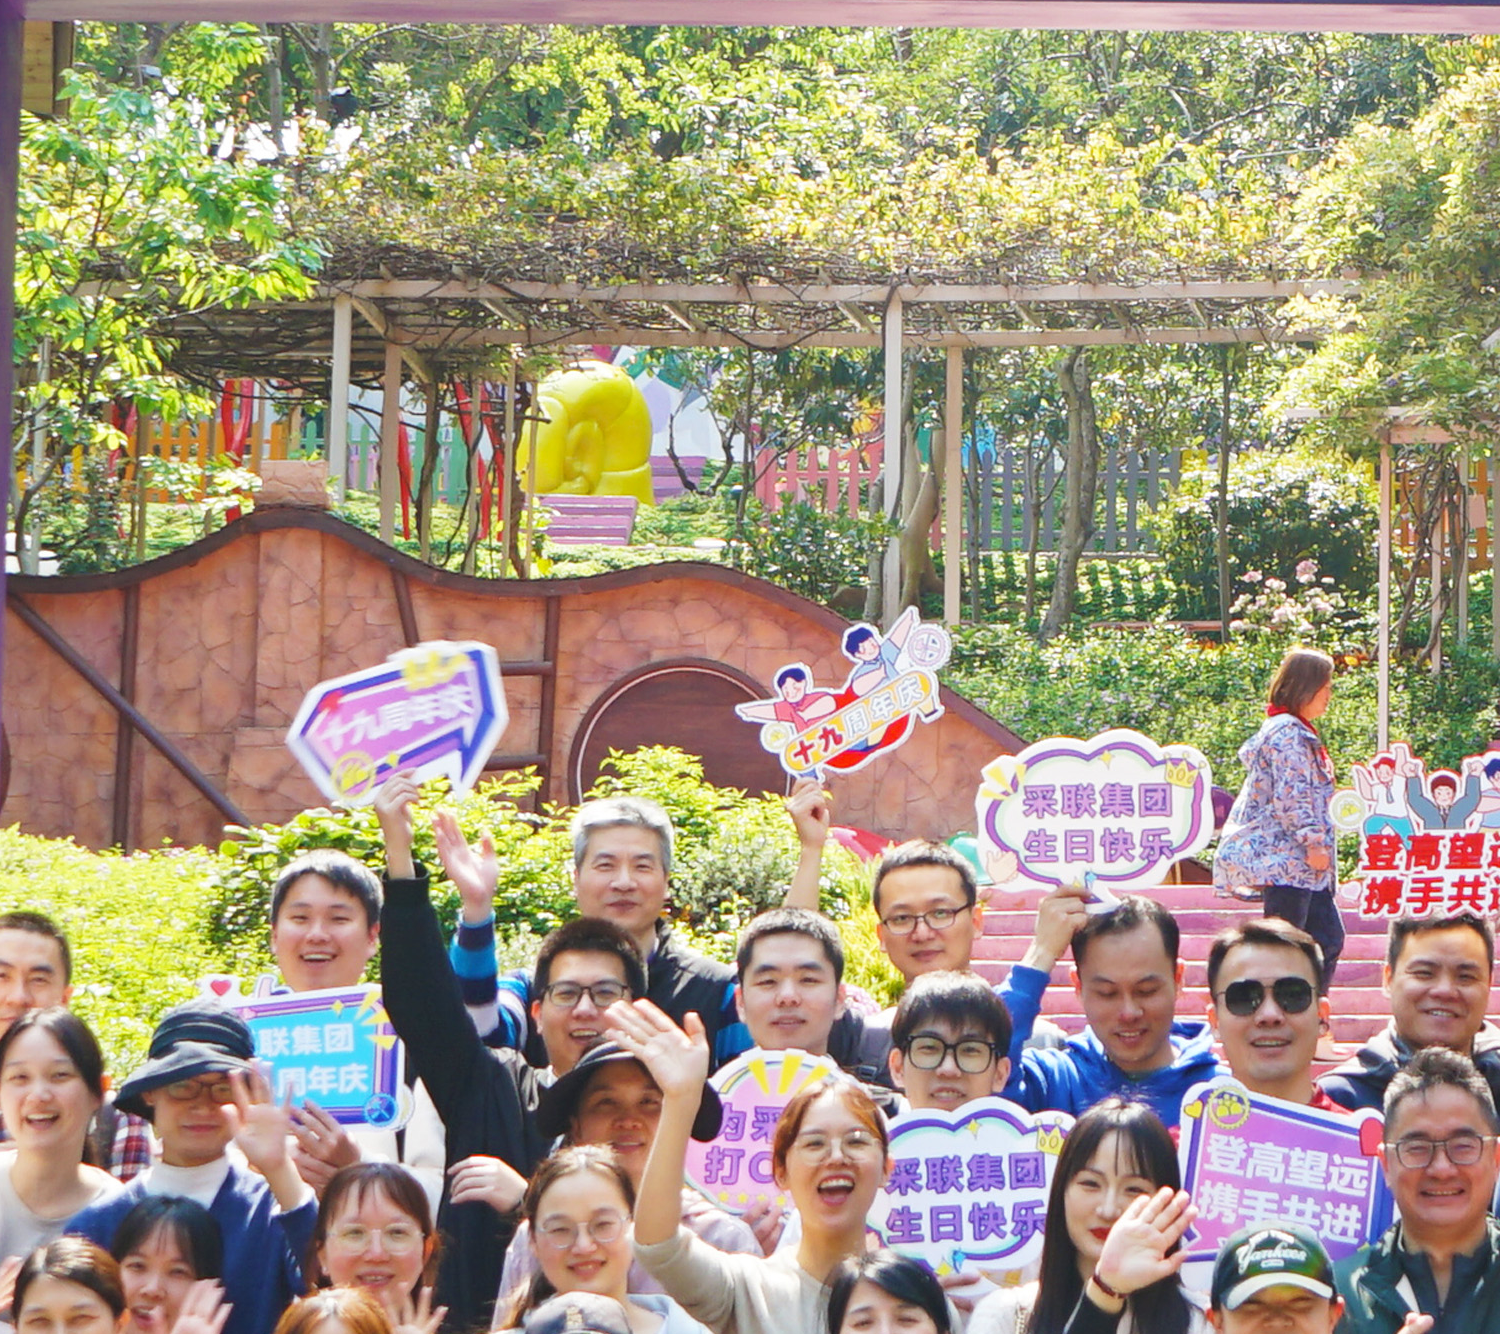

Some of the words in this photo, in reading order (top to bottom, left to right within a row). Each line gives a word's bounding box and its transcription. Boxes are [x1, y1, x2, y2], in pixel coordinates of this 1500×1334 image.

[793, 676, 923, 765] 十九周年庆
[1022, 782, 1173, 819] 采联集团
[1022, 827, 1175, 864] 生日快乐
[884, 1151, 1047, 1196] 采联集团
[1202, 1132, 1369, 1198] 登高望远
[885, 1199, 1048, 1244] 生日快乐
